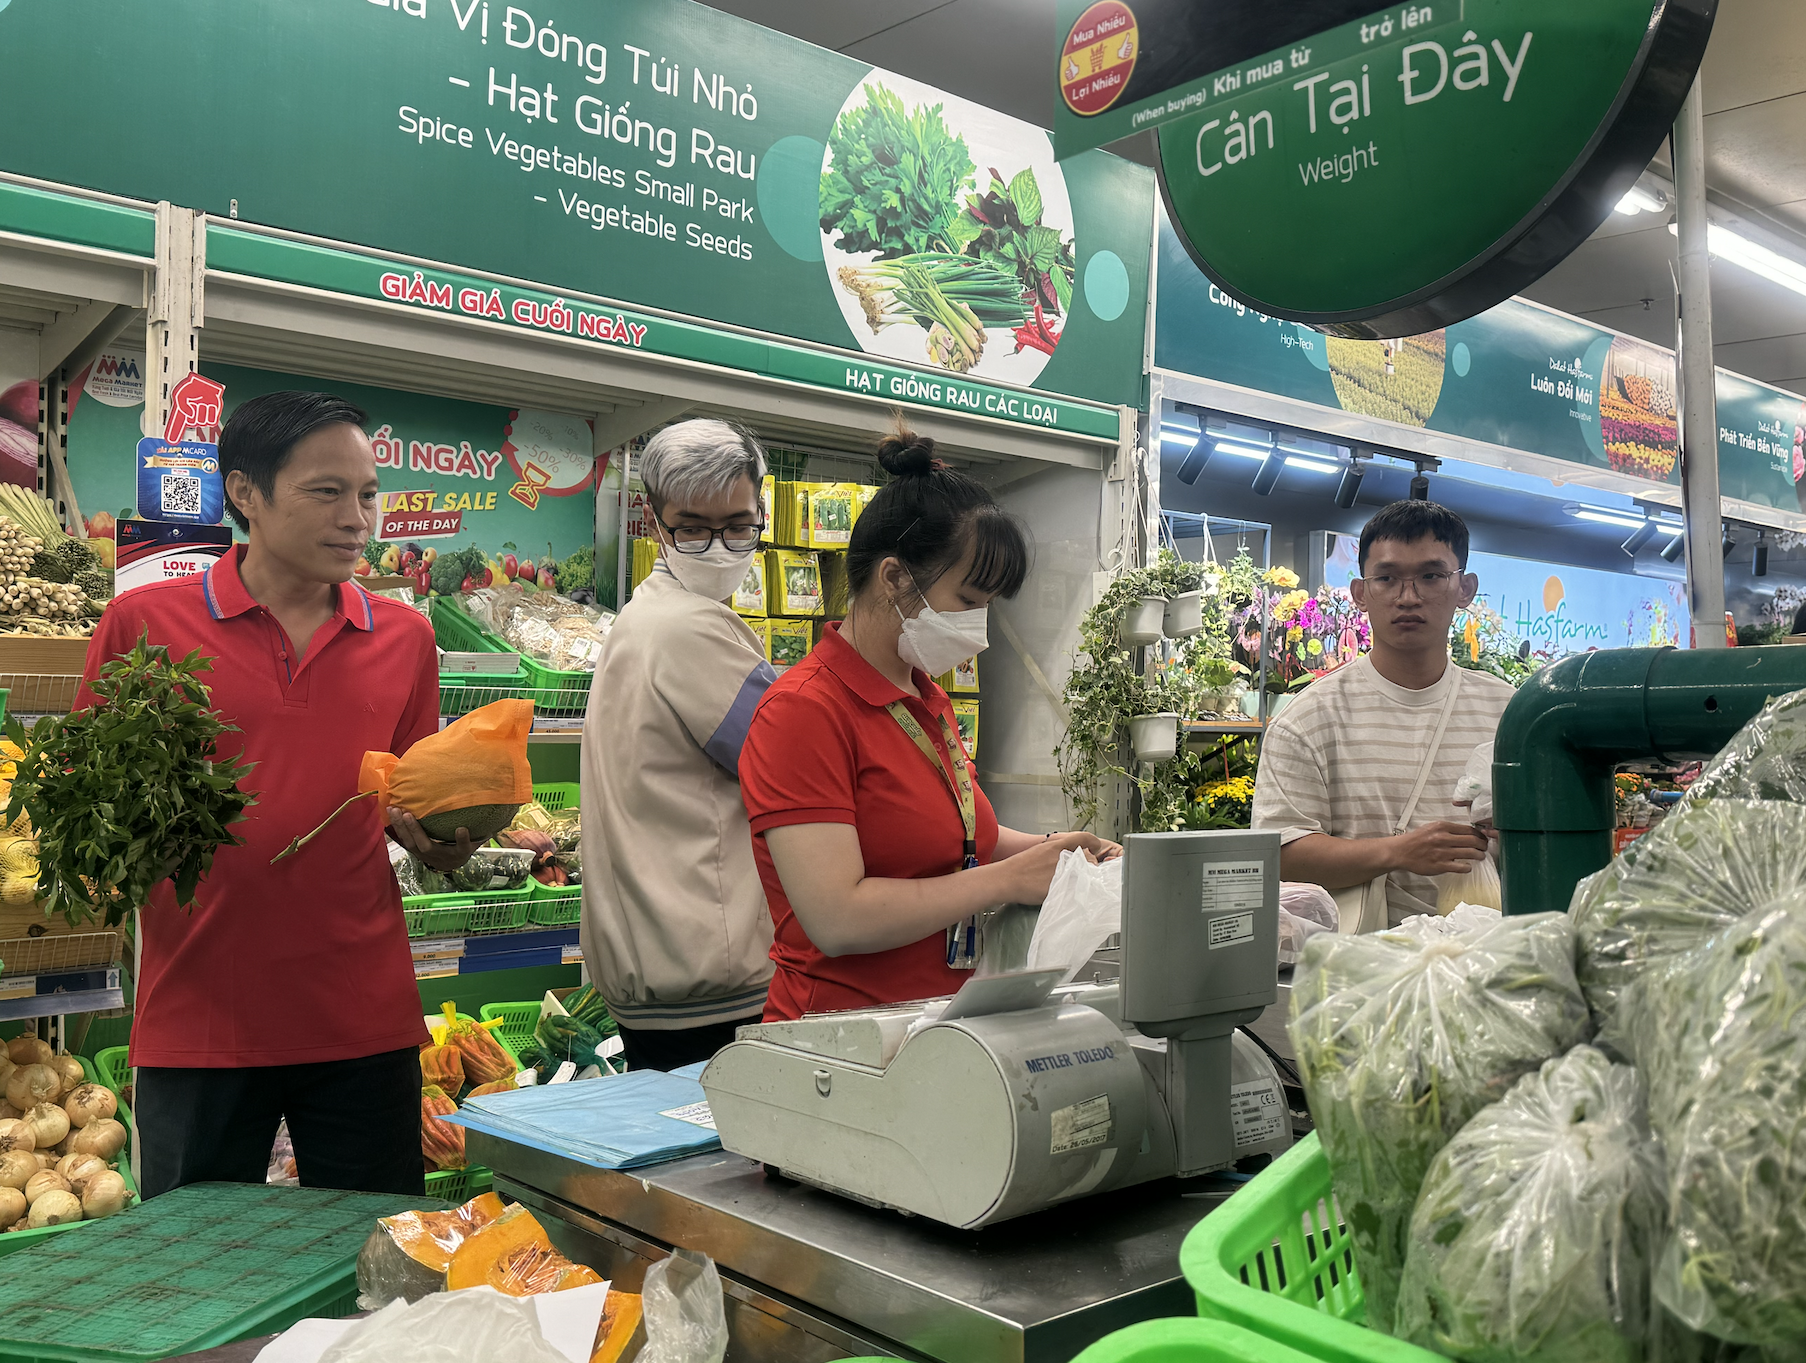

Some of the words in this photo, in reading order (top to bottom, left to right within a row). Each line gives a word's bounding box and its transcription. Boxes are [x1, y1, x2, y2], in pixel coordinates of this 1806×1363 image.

[450, 0, 490, 45] Vị
[502, 5, 608, 85] Đóng
[623, 43, 680, 98] Túi
[693, 66, 758, 121] Nhỏ
[1072, 29, 1096, 46] Mua
[1072, 83, 1090, 101] Lợi
[1131, 105, 1165, 128] (When
[1166, 87, 1207, 113] buying)
[1213, 70, 1242, 97] Khi
[1246, 58, 1284, 85] mua
[1290, 46, 1311, 69] từ
[1360, 14, 1394, 44] trở
[1401, 6, 1433, 31] lên
[487, 66, 559, 125] Hạt
[575, 94, 677, 168] Giống
[690, 127, 756, 181] Rau
[1195, 109, 1275, 177] Cân
[1292, 63, 1372, 135] Tại
[1397, 29, 1534, 106] Đây
[398, 105, 474, 149] Spice
[485, 127, 627, 189] Vegetables
[634, 169, 695, 208] Small
[702, 187, 755, 225] Park
[1298, 140, 1380, 187] Weight
[557, 187, 678, 242] Vegetable
[685, 222, 754, 262] Seeds
[379, 271, 453, 309] GIẢM
[458, 287, 506, 320] GIÁ
[511, 297, 574, 333] CUỐI
[578, 313, 648, 347] NGÀY
[845, 368, 885, 394] HẠT
[890, 372, 942, 403] GIỐNG
[946, 386, 981, 409] RAU
[985, 393, 1019, 416] CÁC
[1023, 402, 1059, 427] LOẠI
[1530, 372, 1555, 395] Luôn
[1557, 379, 1574, 401] Đổi
[371, 424, 401, 467] ỐI
[409, 441, 501, 481] NGÀY
[523, 442, 560, 475] -50%
[559, 446, 587, 472] -30%
[381, 491, 439, 514] LAST
[443, 491, 498, 512] SALE
[385, 521, 405, 533] OF
[406, 519, 430, 532] THE
[432, 518, 460, 530] DAY
[163, 560, 196, 571] LOVE
[1025, 1053, 1073, 1074] METTLER
[1072, 1046, 1115, 1065] TOLEDO
